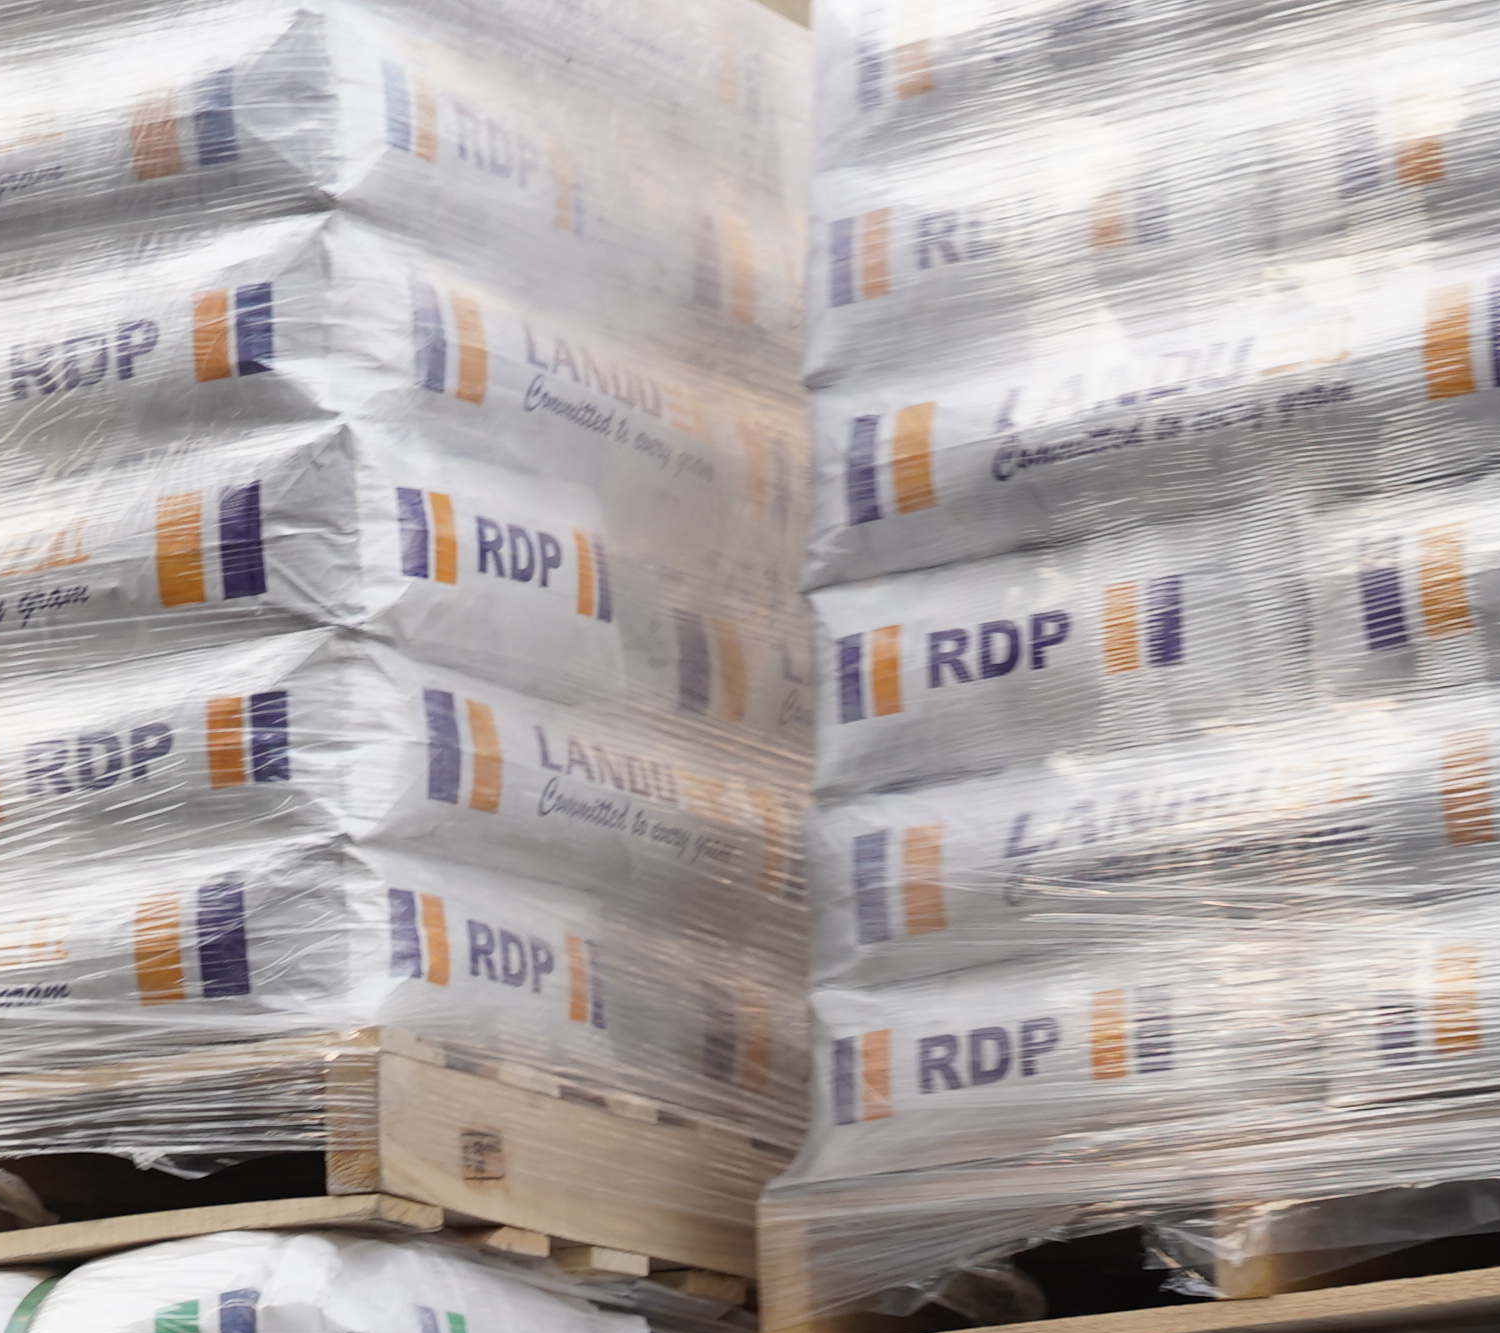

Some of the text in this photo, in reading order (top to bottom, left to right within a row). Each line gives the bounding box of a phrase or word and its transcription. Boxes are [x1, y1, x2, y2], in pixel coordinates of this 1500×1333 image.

[10, 318, 160, 401] RDP
[475, 514, 561, 588] RDP
[926, 609, 1073, 690] RDP
[26, 720, 175, 798] RDP
[533, 724, 677, 805] LANDU
[537, 776, 628, 833] Committed
[465, 918, 556, 994] RDP
[917, 1014, 1063, 1095] RDP
